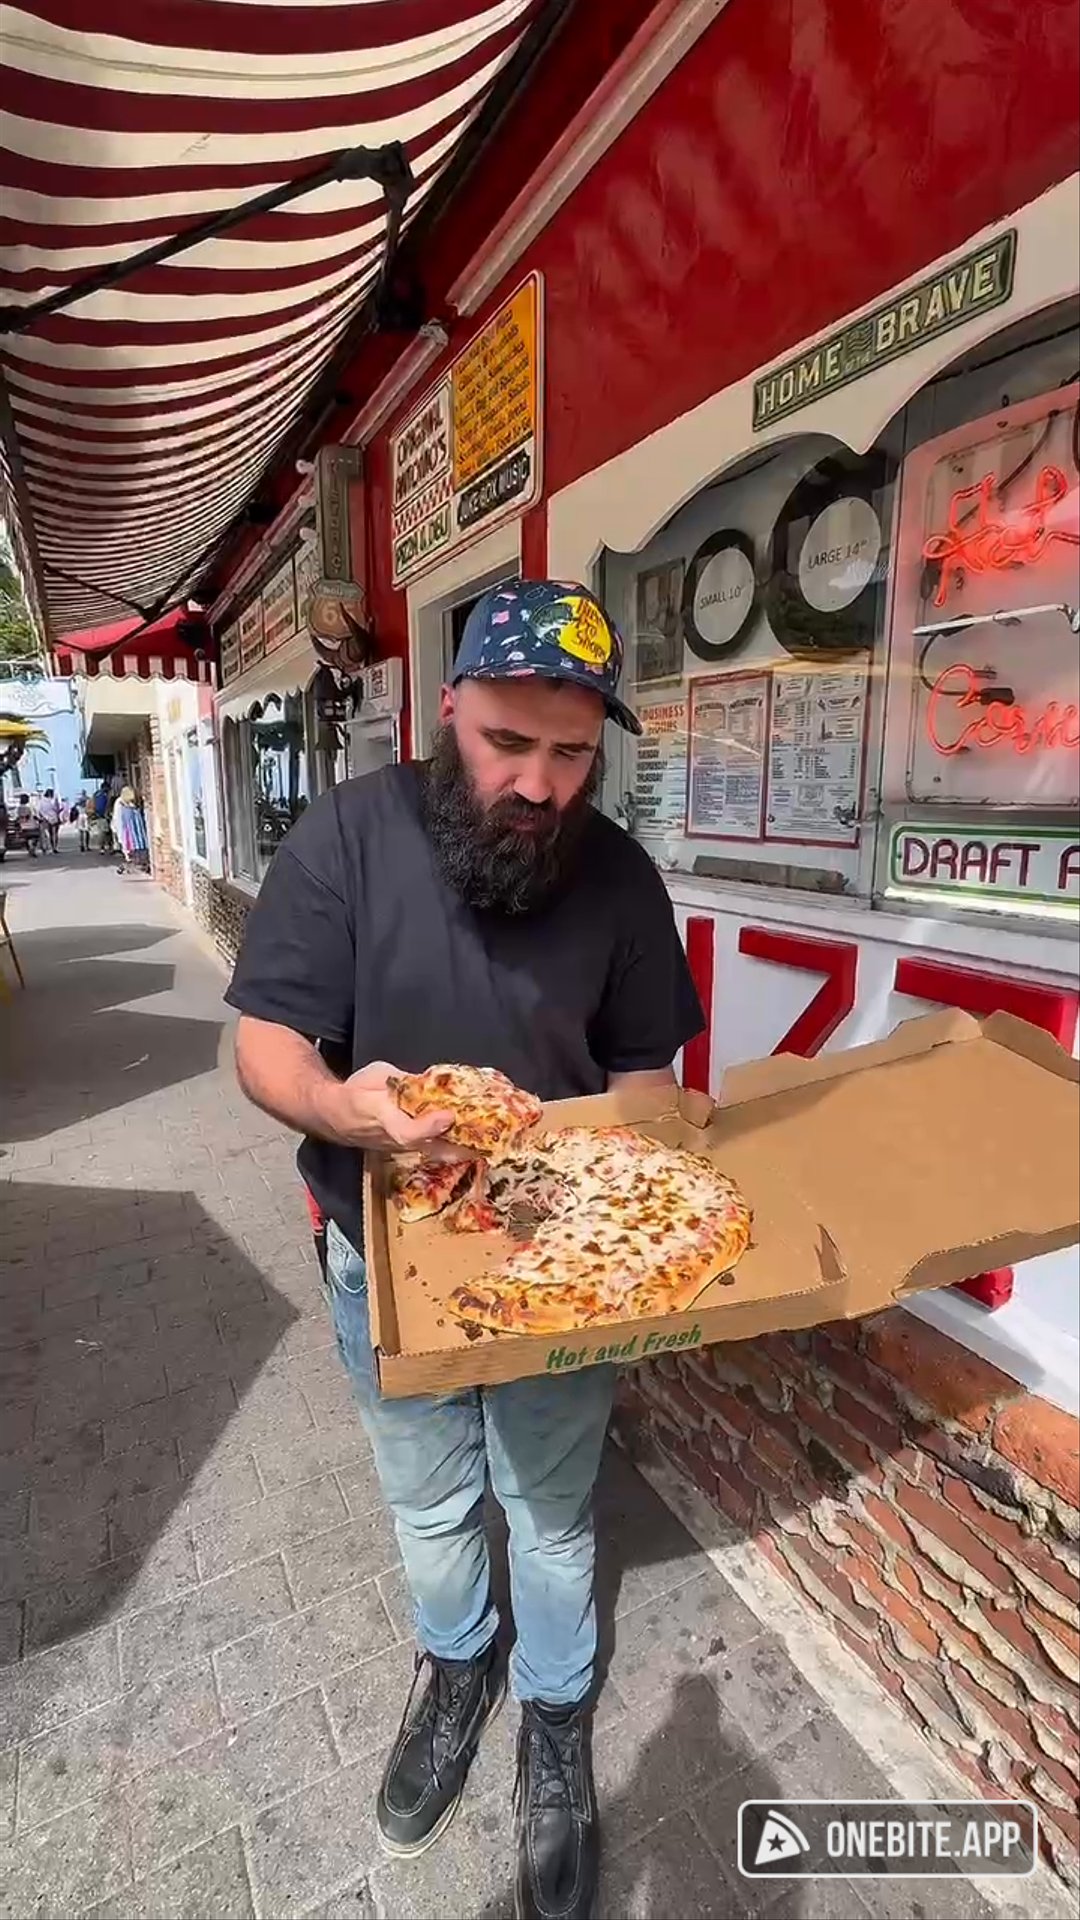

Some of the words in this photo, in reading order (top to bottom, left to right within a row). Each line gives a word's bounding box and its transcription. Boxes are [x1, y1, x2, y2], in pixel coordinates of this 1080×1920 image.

[757, 343, 843, 415] HOME
[876, 254, 998, 352] BRAVE
[808, 546, 842, 569] LARGE
[700, 592, 727, 609] SMALL
[642, 704, 684, 721] BUSINESS
[902, 837, 1041, 886] DRAFT
[547, 1347, 584, 1369] Hot
[595, 1334, 638, 1361] and
[643, 1324, 701, 1353] Fresh
